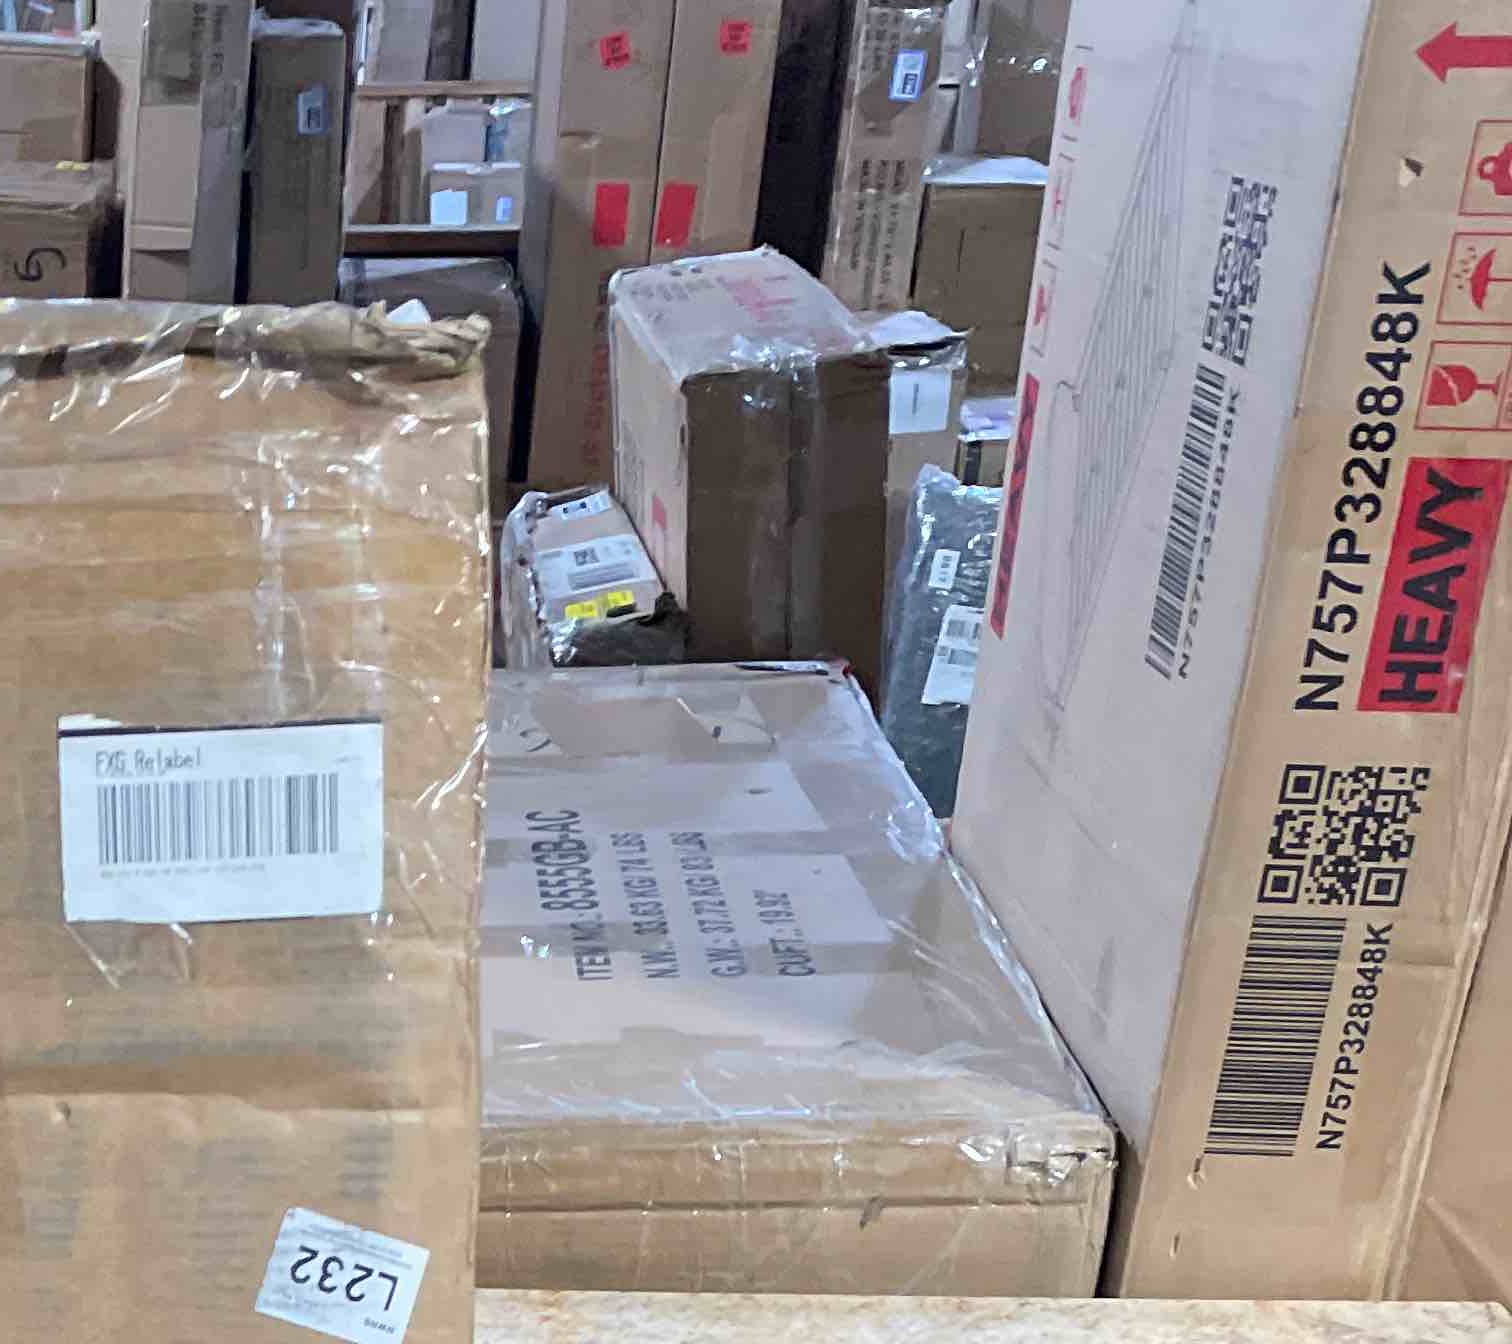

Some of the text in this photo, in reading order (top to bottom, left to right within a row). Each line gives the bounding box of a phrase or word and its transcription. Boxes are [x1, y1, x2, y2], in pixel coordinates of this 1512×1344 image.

[1294, 261, 1431, 712] N757P328848K
[1379, 466, 1484, 705] HEAVY
[574, 943, 614, 981] ITEM
[1316, 922, 1393, 1150] N757P328848K
[289, 1244, 399, 1312] L232
